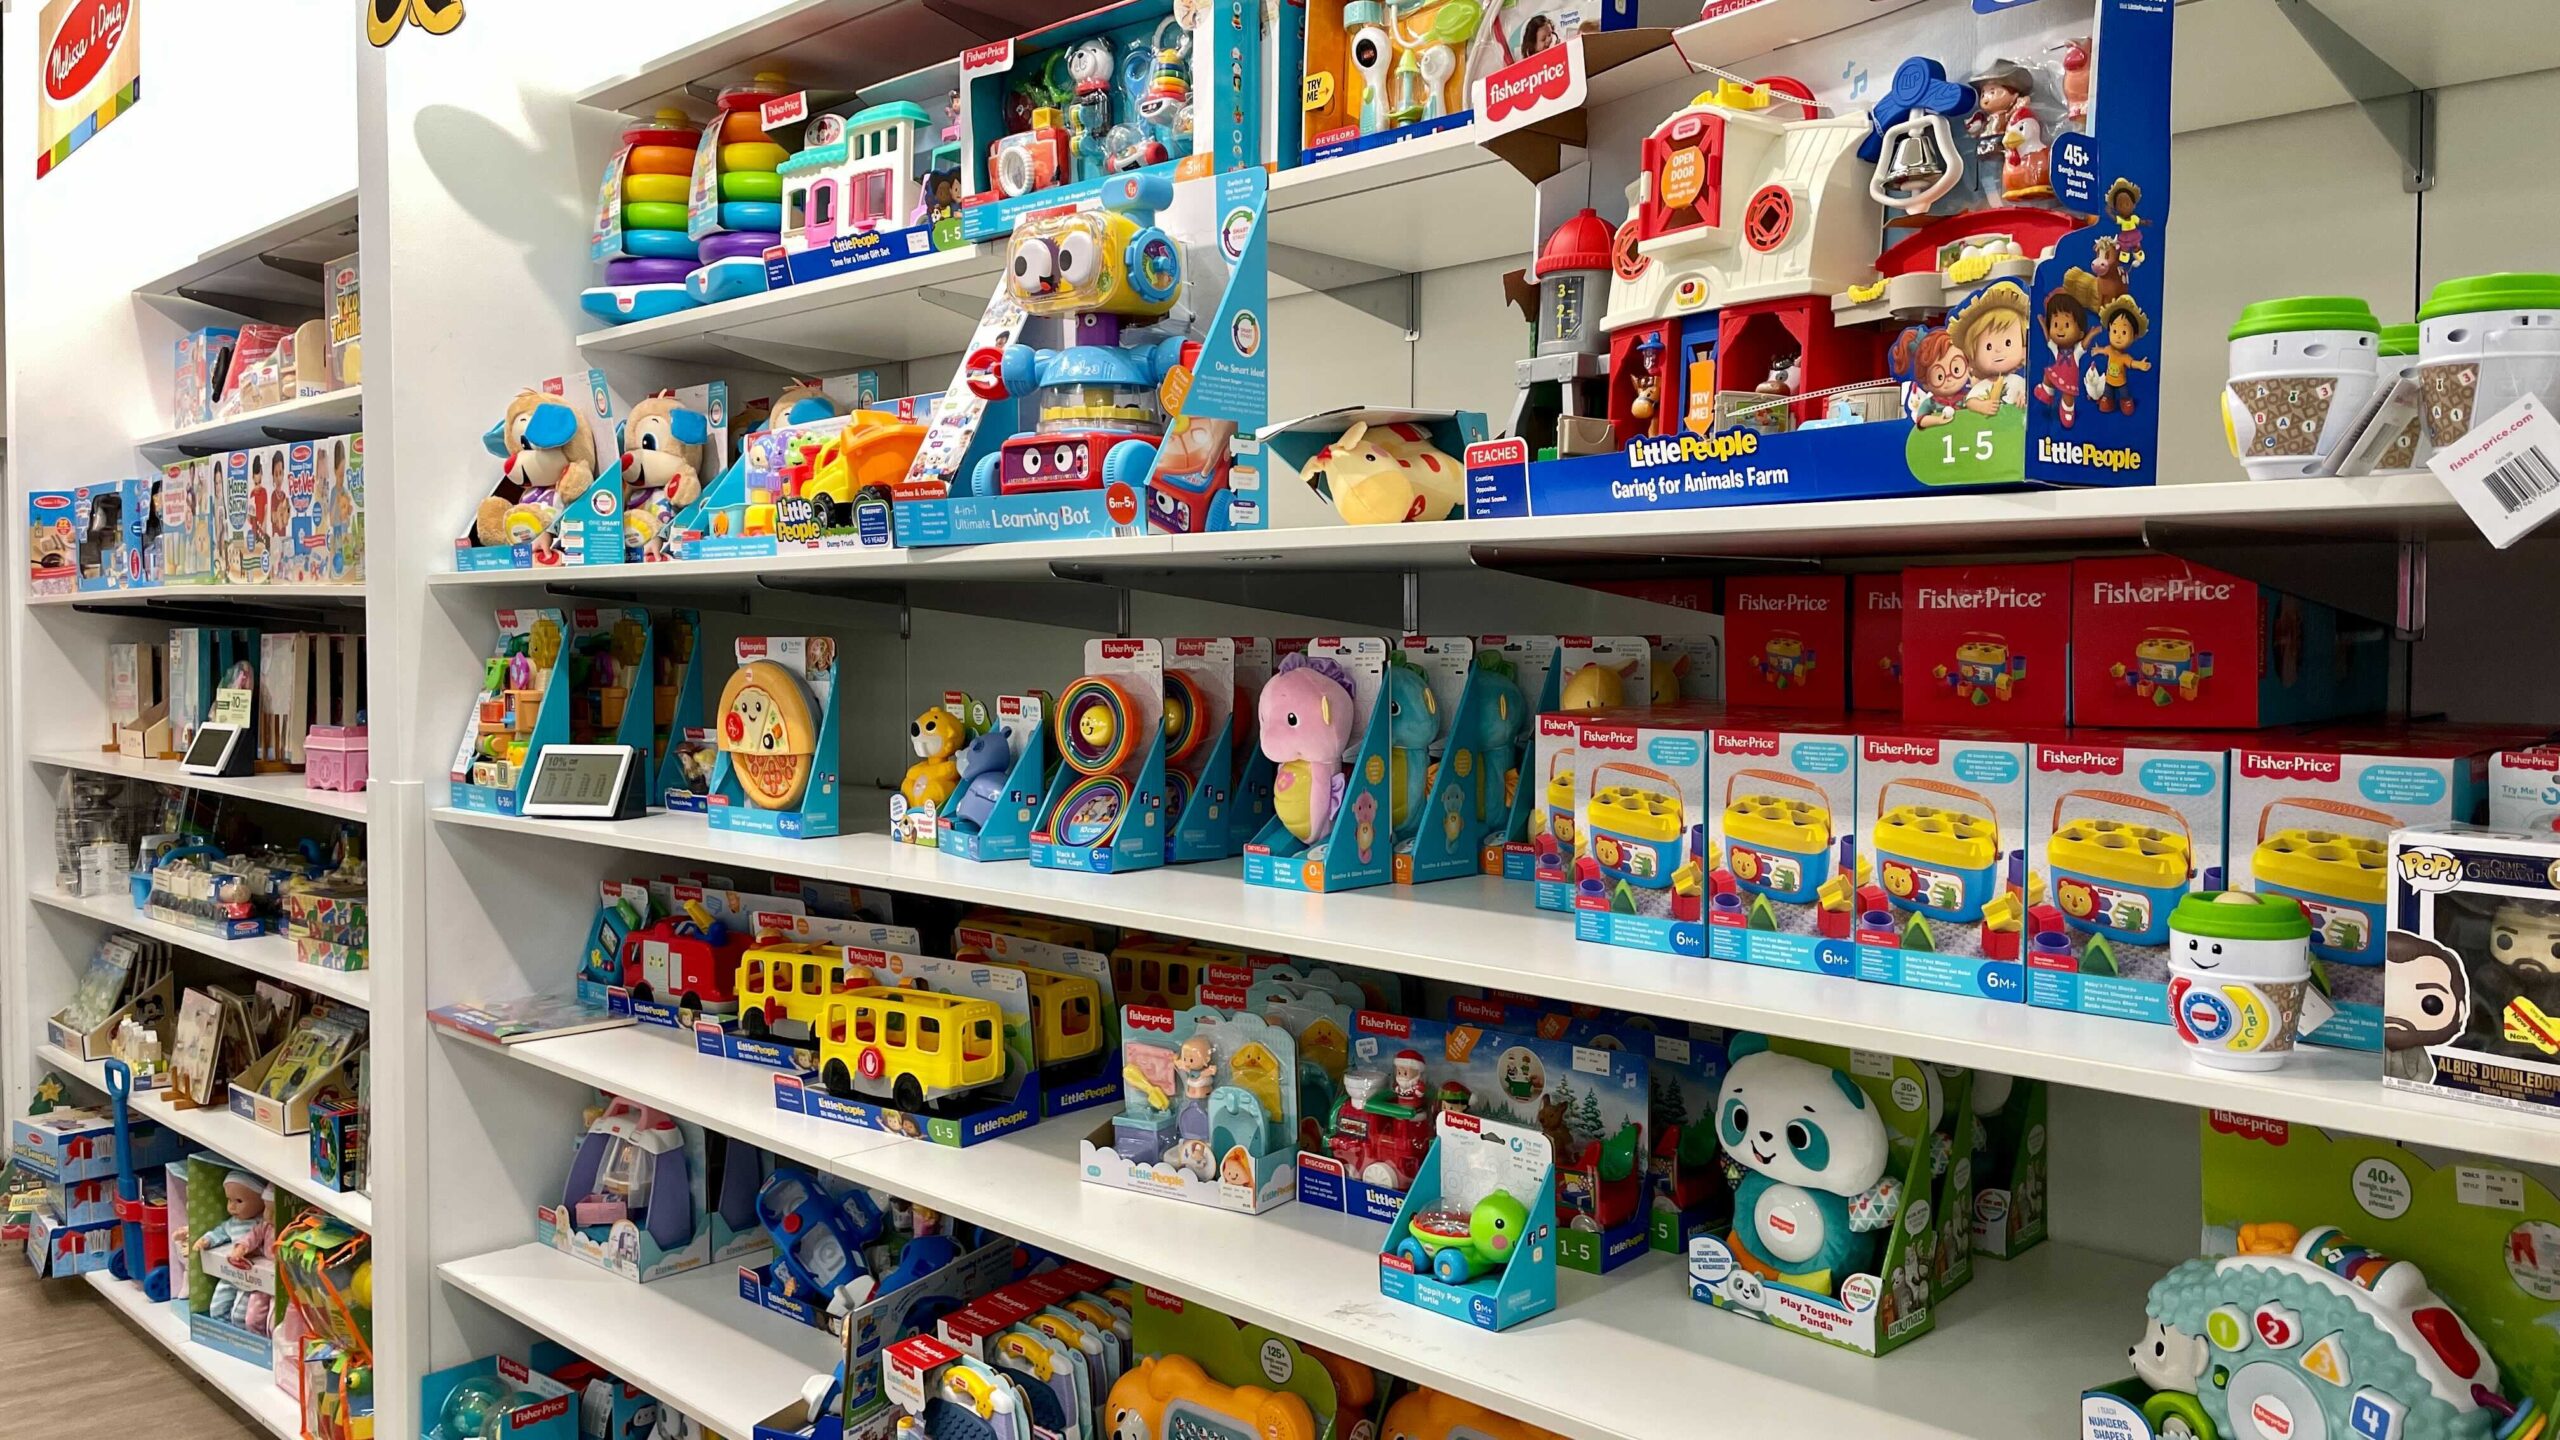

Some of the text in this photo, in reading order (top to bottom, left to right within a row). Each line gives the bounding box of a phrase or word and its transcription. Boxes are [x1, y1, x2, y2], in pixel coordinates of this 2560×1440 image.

[1710, 0, 1759, 17] TEACHE
[51, 2, 121, 90] Melissa Doug
[966, 44, 1005, 62] Fisher-Price
[1307, 77, 1322, 92] TRY
[1490, 64, 1564, 105] fisher-price
[1306, 93, 1318, 103] ME
[1673, 152, 1694, 167] OPEN
[2064, 144, 2089, 166] 45+
[1671, 166, 1695, 181] DOOR
[943, 226, 961, 243] 1-5
[901, 399, 911, 411] Try
[1691, 392, 1710, 407] TRY
[1691, 407, 1710, 420] ME!
[2279, 418, 2287, 427] A
[1942, 430, 1994, 464] 1-5
[2448, 413, 2534, 472] fisher-price.com
[1471, 446, 1518, 464] TEACHES
[1612, 467, 1789, 501] Caring for Animals Farm
[778, 499, 813, 523] Little
[955, 517, 991, 531] Ultimate
[992, 506, 1091, 535] Learning Bot
[777, 518, 820, 541] People
[1918, 586, 2044, 611] Fisher-Price
[2092, 581, 2234, 605] Fisher-Price
[1739, 593, 1829, 611] Fisher-Price
[1584, 729, 1634, 744] Fisher-Price
[1719, 736, 1775, 750] Fisher-Price
[1869, 742, 1935, 757] Fisher-Price
[2043, 750, 2118, 767] Fisher-Price
[2247, 755, 2335, 773] Fisher-Price
[2505, 754, 2555, 767] Fisher-Price
[2502, 785, 2538, 796] Try Me!
[2397, 851, 2462, 882] POP!
[1676, 931, 1699, 947] 6M+
[1823, 949, 1849, 965] 6M+
[1987, 971, 2017, 989] 6M+
[1202, 989, 1244, 1004] fisher-price
[1129, 1010, 1172, 1025] fisher-price
[2244, 1003, 2255, 1015] A
[1361, 1016, 1406, 1032] Fisher-Price
[2249, 1016, 2258, 1026] B
[2245, 1027, 2254, 1038] C
[2438, 1057, 2560, 1091] ALBUS DUMBLEDOR
[1447, 1114, 1479, 1129] Fisher-Price
[935, 1125, 953, 1139] 1-5
[1305, 1158, 1335, 1172] DISCOVER
[2367, 1167, 2396, 1184] 40+
[1560, 1240, 1591, 1261] 1-5
[1382, 1256, 1412, 1271] DEVELOPS
[220, 1264, 237, 1281] Mine
[245, 1272, 262, 1287] Love
[1418, 1283, 1446, 1299] Poppity
[1446, 1290, 1461, 1304] Pop
[1418, 1292, 1439, 1306] Turtle
[1473, 1299, 1492, 1314] 6M+
[1780, 1296, 1853, 1327] Play Together
[1800, 1313, 1833, 1332] Panda
[2219, 1318, 2229, 1343] 1
[2266, 1318, 2280, 1342] 2
[912, 1339, 946, 1360] fisher-price
[1267, 1345, 1285, 1358] 125+
[2316, 1349, 2332, 1375] 3
[516, 1400, 565, 1425] Fisher-Price
[2363, 1403, 2380, 1429] 4
[2088, 1415, 2132, 1431] NUMBERS,
[2093, 1428, 2127, 1440] SHAPES
